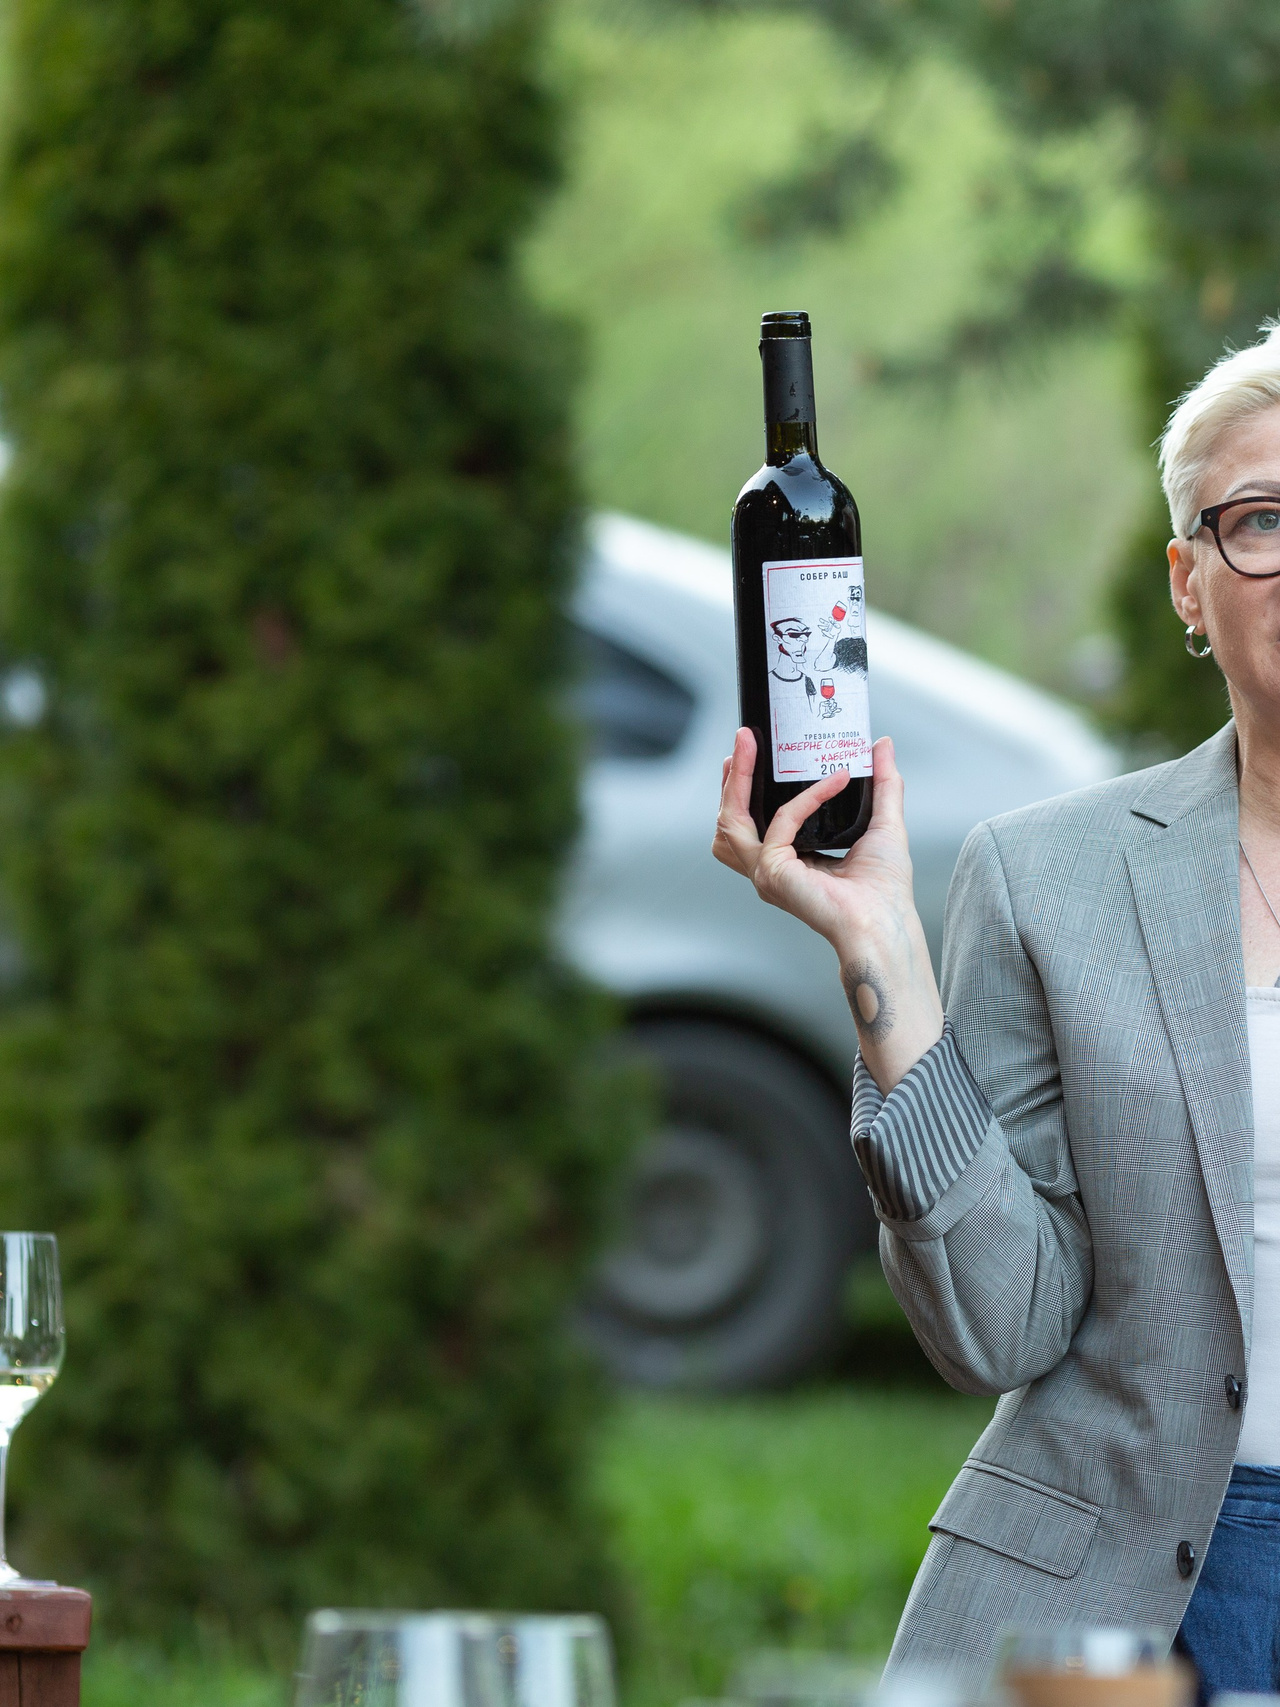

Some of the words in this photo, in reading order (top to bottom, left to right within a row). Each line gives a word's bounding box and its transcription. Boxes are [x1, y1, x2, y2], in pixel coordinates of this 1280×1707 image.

[800, 572, 828, 580] СОБЕР
[832, 571, 848, 579] БАШ
[838, 731, 860, 739] ГОЛОВА
[778, 741, 823, 752] КАБЕРНЕ
[821, 749, 858, 762] КАБЕРНЕ
